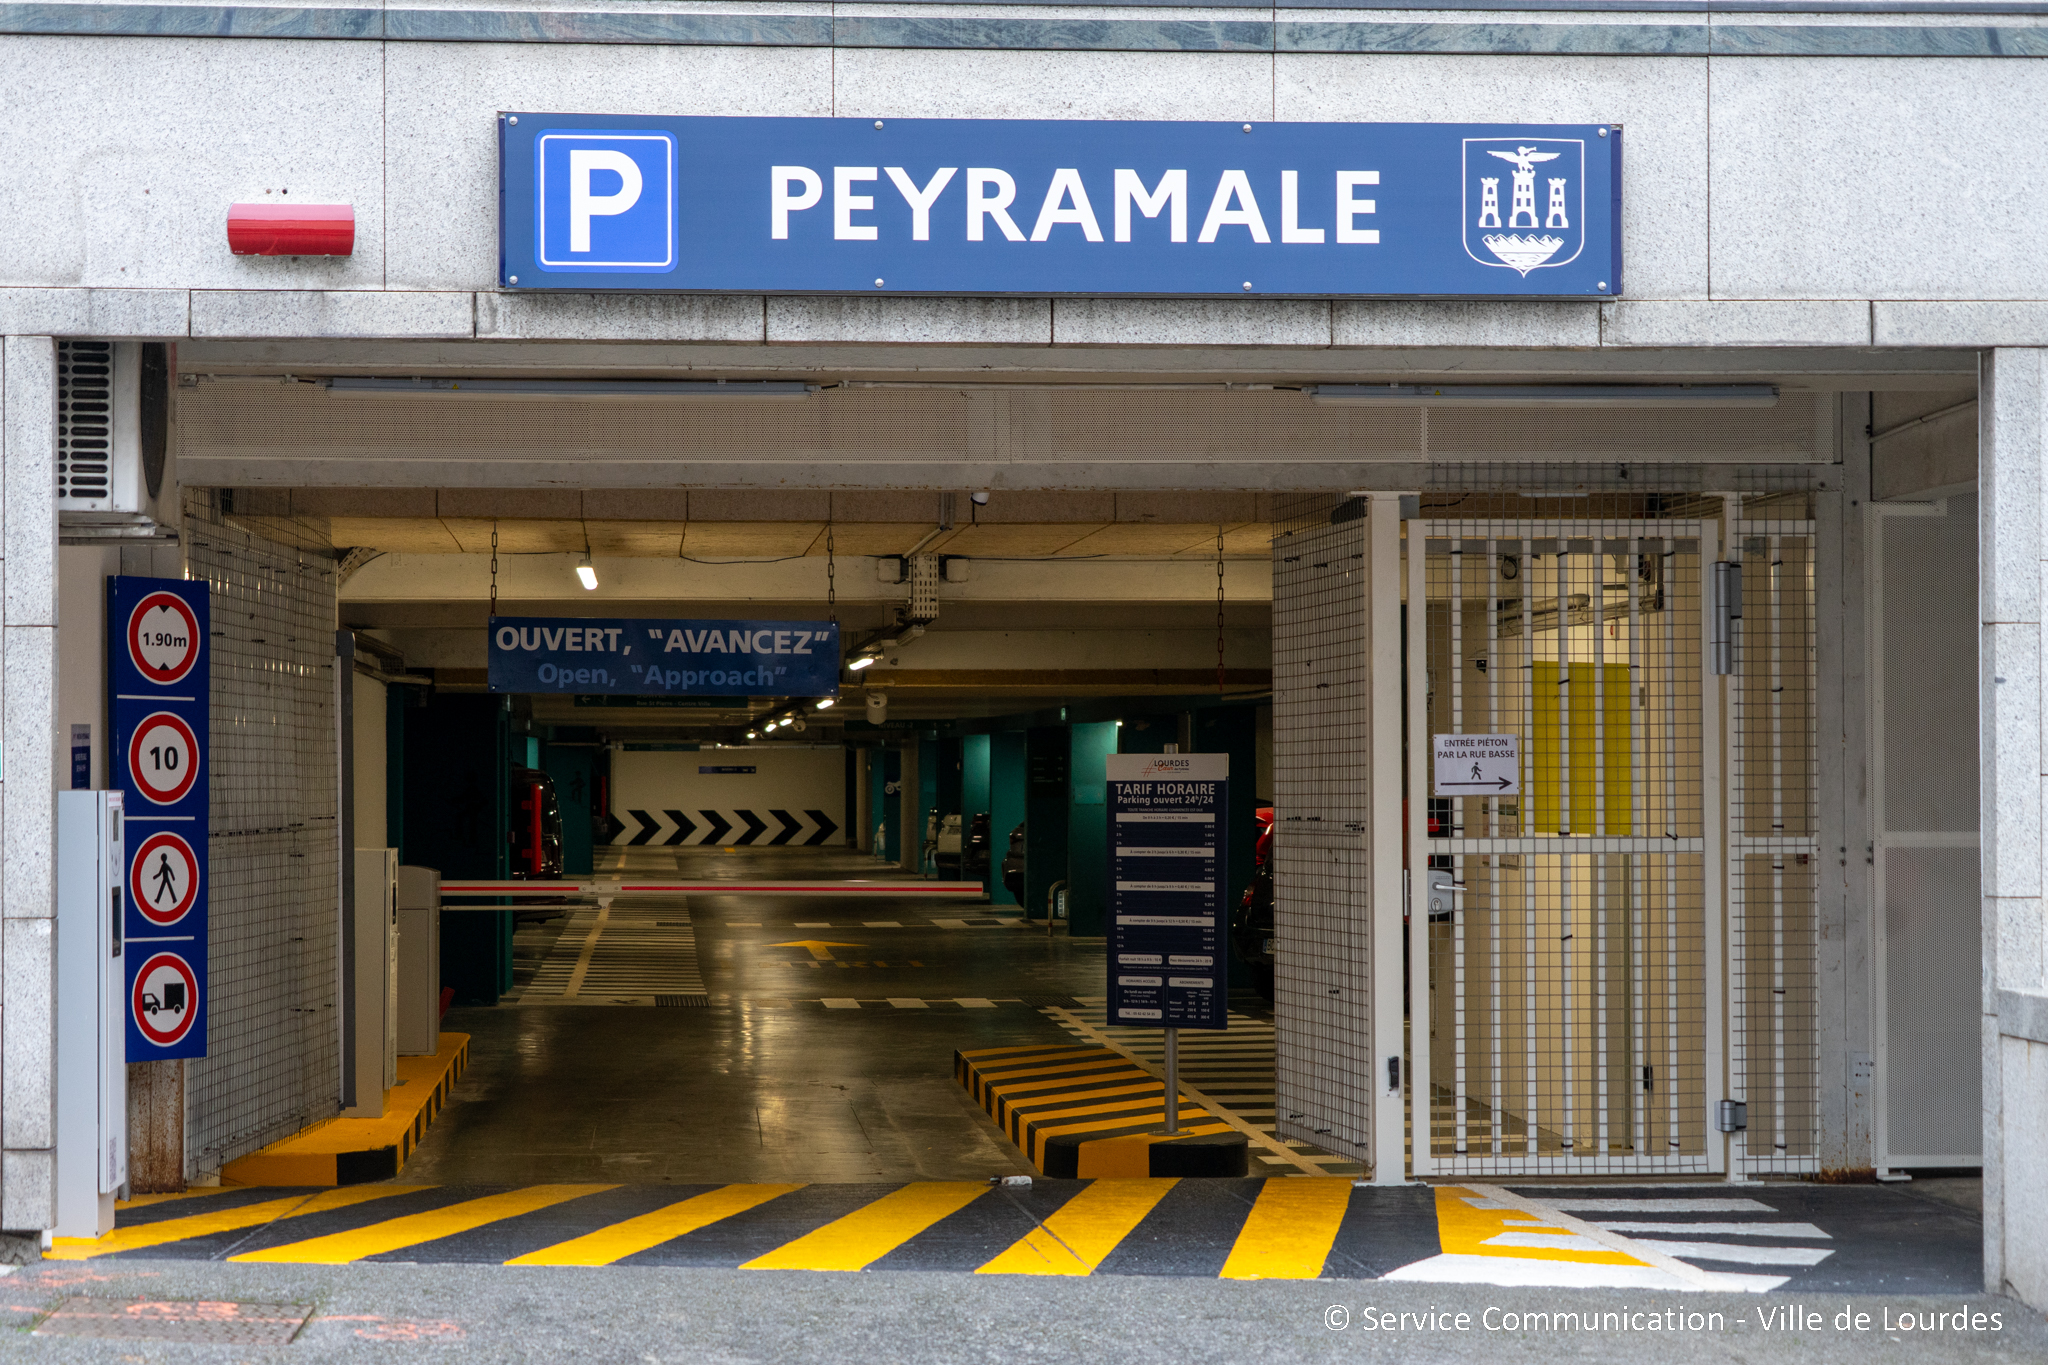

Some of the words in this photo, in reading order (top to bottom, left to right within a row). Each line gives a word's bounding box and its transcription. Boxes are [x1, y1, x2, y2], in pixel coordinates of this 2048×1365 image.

[570, 149, 643, 252] P
[771, 165, 1380, 244] PEYRAMALE
[143, 632, 187, 647] 1.90m
[495, 626, 632, 656] OUVERT,
[537, 662, 616, 688] Open,
[1444, 737, 1475, 747] ENTRÉE
[1477, 737, 1508, 747] PIÉTON
[150, 746, 179, 771] 10
[1437, 751, 1455, 759] PAR
[1456, 750, 1468, 759] LA
[1469, 750, 1487, 758] RUE
[1488, 750, 1515, 758] BASSE
[1115, 783, 1153, 795] TARIF
[1157, 783, 1215, 795] HORAIRE
[1117, 795, 1151, 806] Parking
[1153, 796, 1183, 804] ouvert
